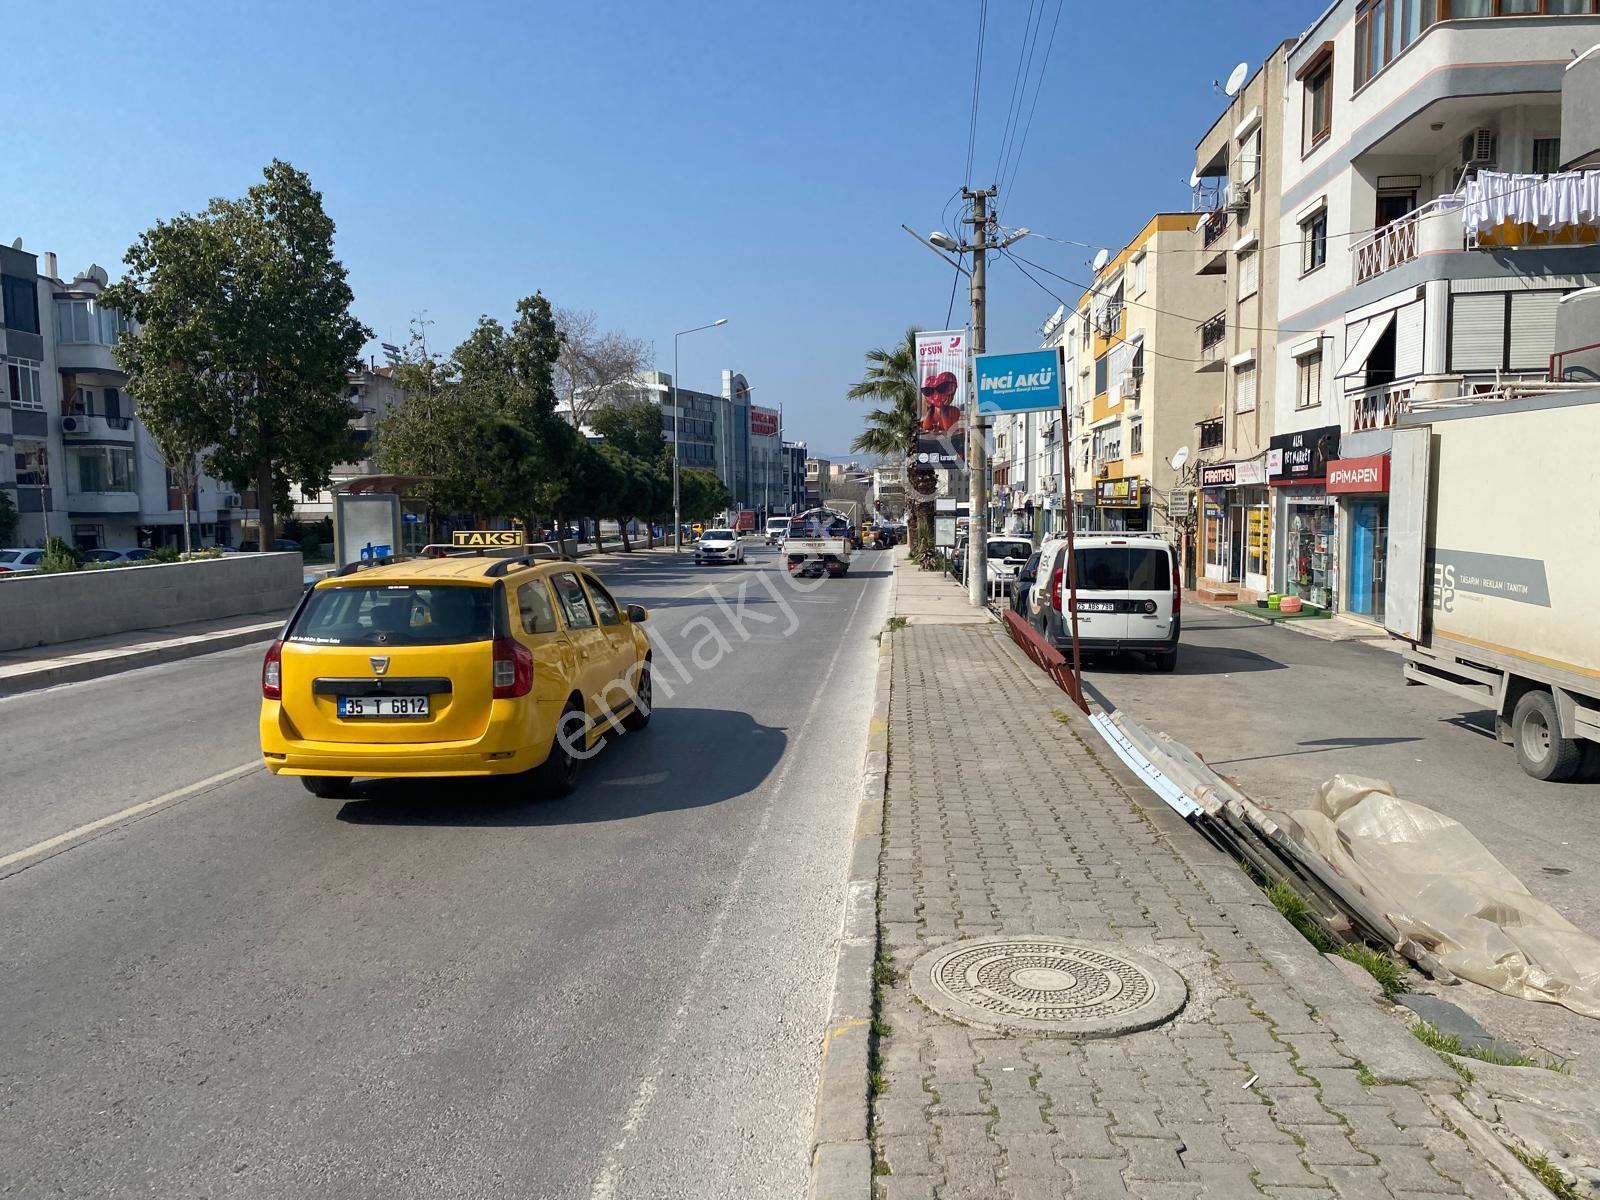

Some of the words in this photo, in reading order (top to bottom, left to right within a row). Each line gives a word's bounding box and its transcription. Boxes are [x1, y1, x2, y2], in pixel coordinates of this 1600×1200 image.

[981, 370, 1012, 390] İNCİ
[1015, 367, 1052, 387] AKÜ
[1292, 434, 1303, 447] ALFA
[1284, 450, 1292, 464] PET
[1293, 448, 1311, 464] MARKET
[1483, 578, 1503, 589] REKLAM
[1506, 582, 1528, 594] TANITIM
[347, 699, 363, 714] 35
[374, 699, 382, 714] T
[391, 698, 426, 714] 6812
